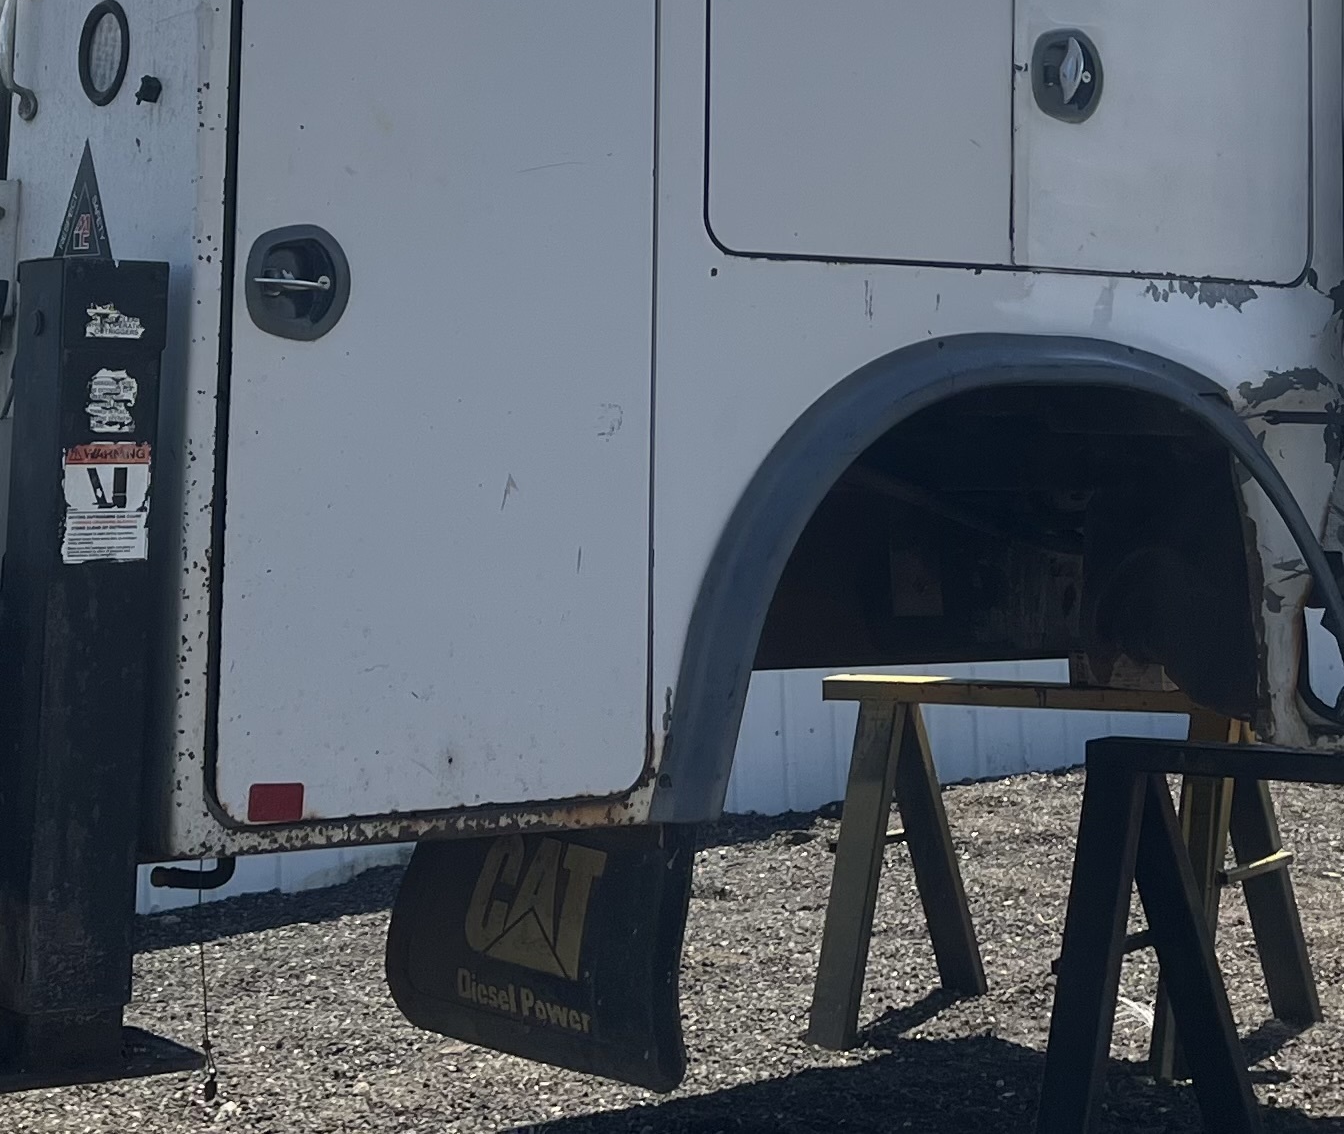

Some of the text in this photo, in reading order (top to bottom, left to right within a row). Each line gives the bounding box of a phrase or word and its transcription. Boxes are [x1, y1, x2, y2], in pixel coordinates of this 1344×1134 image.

[464, 832, 607, 981] CAT
[457, 967, 592, 1034] Diesel Power
